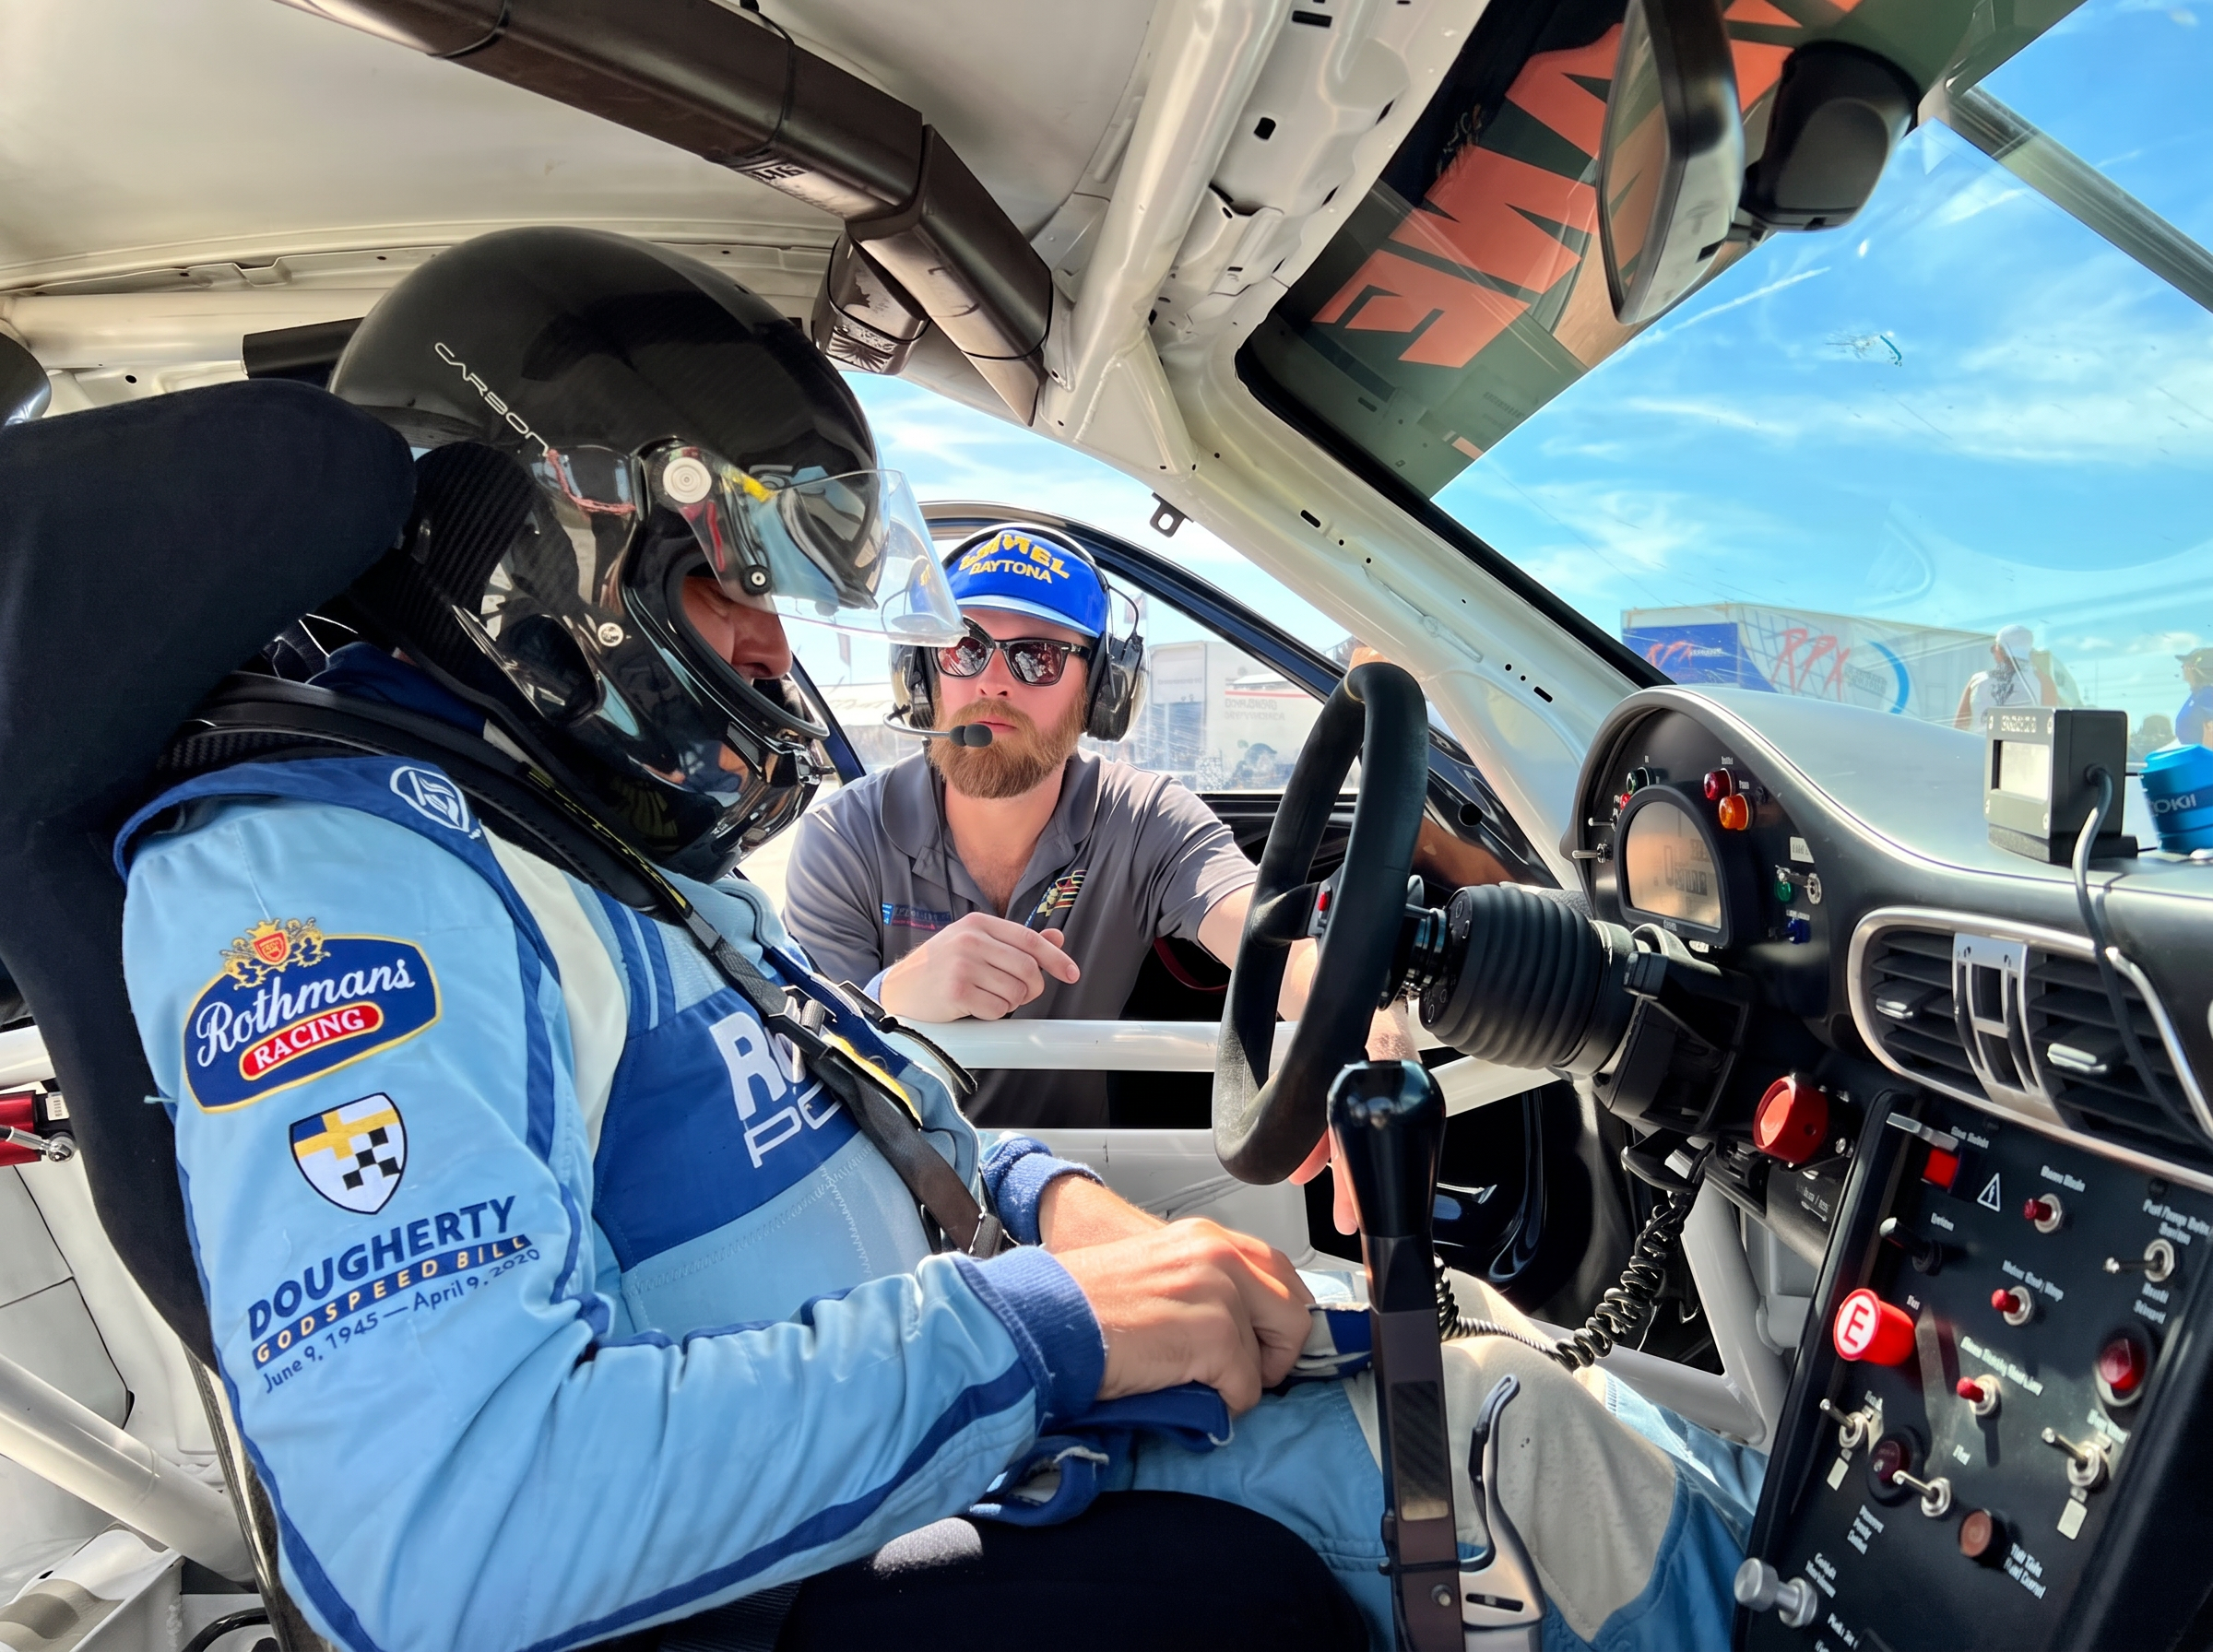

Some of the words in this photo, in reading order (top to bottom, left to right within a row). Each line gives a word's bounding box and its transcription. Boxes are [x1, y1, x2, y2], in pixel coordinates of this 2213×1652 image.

[969, 560, 1052, 584] DAYTONA
[195, 959, 416, 1067] Rothmans
[254, 1009, 364, 1069] RACING
[248, 1195, 516, 1341] DOUGHERTY
[256, 1259, 438, 1363] GODSPEED
[456, 1236, 525, 1269] BILL
[264, 1359, 302, 1394] June
[325, 1312, 378, 1349] 1945
[413, 1280, 464, 1311] April
[489, 1248, 540, 1278] 2020
[1842, 1304, 1870, 1349] E
